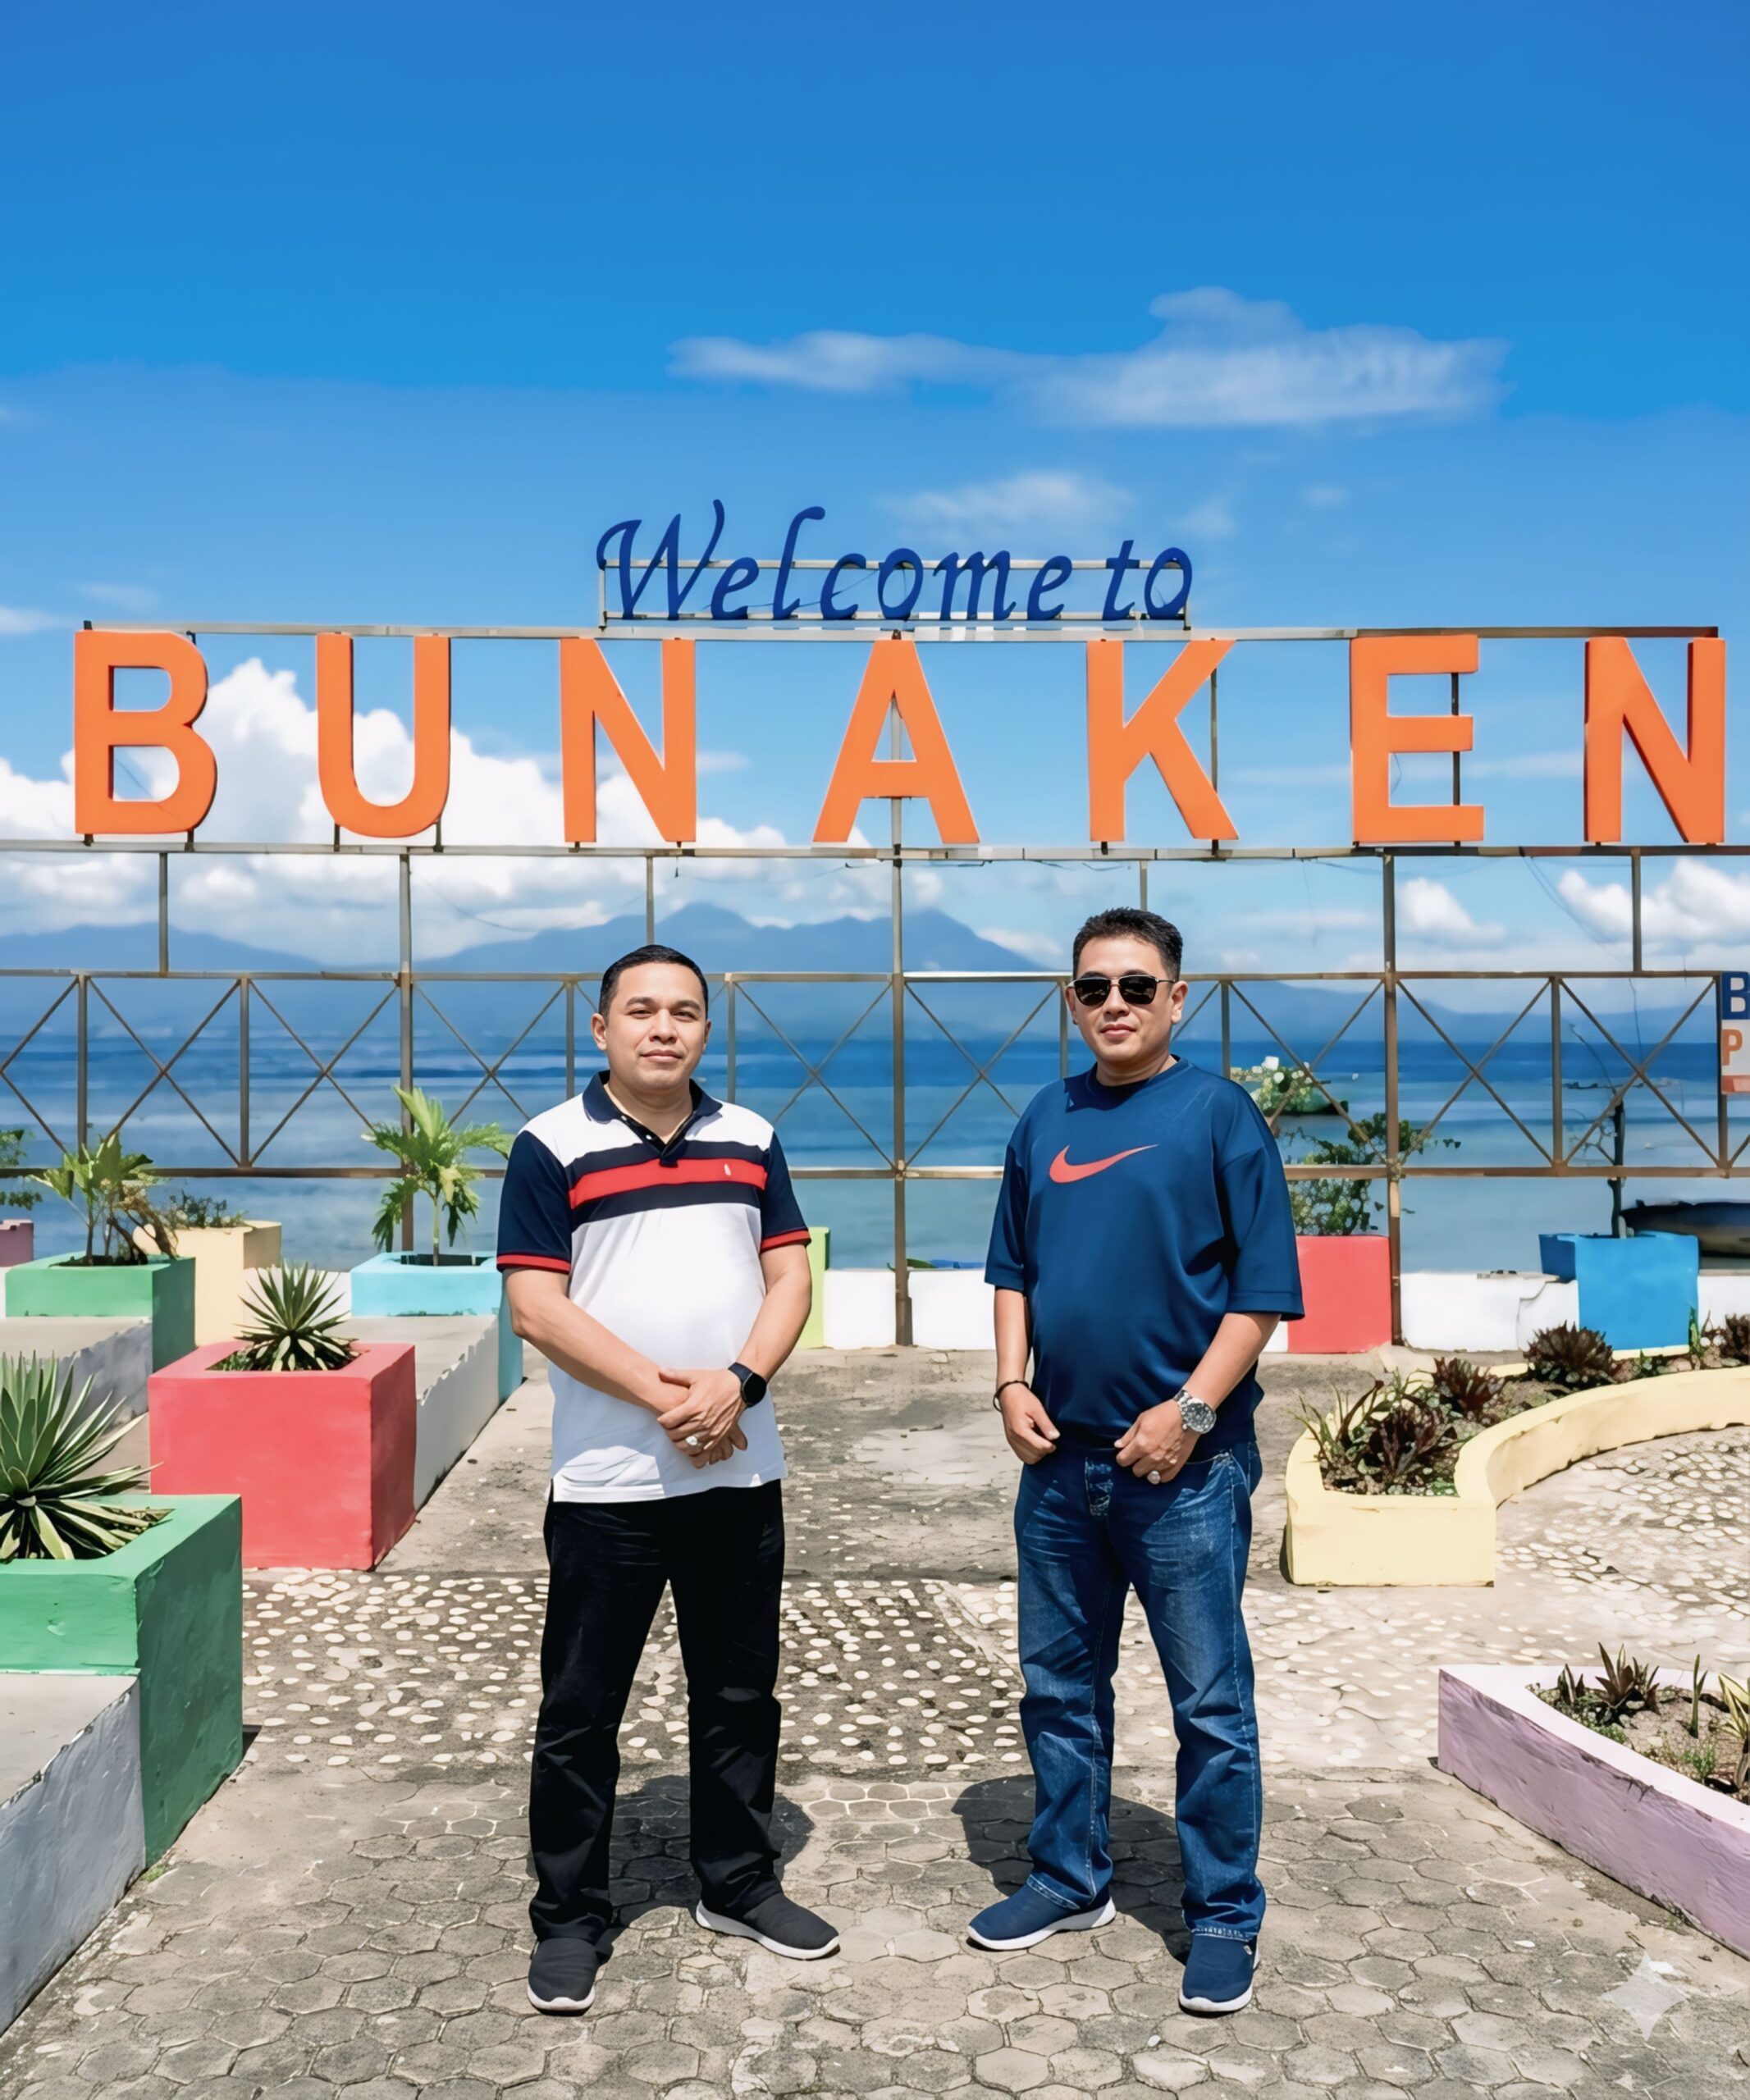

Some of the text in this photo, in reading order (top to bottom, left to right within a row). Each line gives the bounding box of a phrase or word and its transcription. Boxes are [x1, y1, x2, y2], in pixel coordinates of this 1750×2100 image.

[596, 499, 1194, 621] Welcome to
[74, 629, 1726, 845] BUNAKEN
